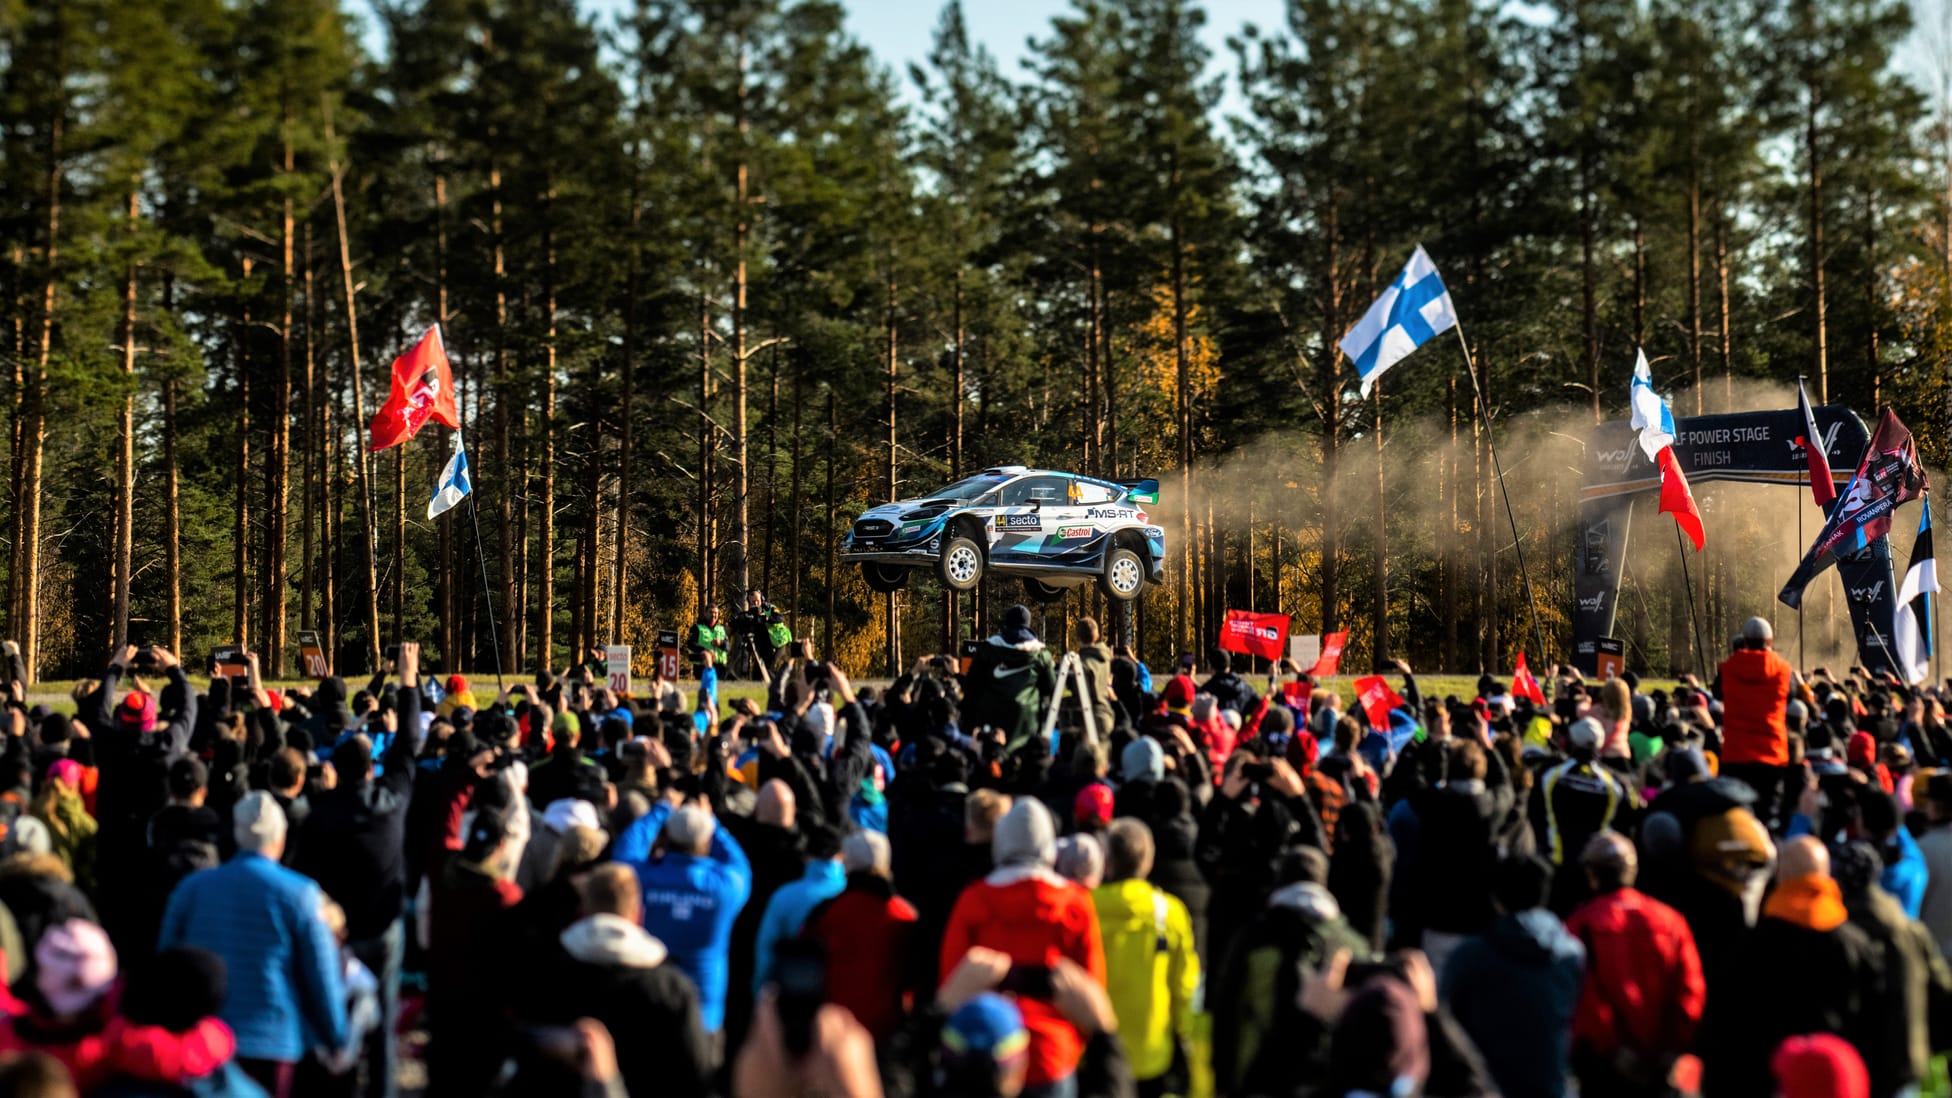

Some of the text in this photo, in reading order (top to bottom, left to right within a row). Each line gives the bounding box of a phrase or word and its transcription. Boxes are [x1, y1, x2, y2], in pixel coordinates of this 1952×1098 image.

[1689, 428, 1731, 446] POWER
[1733, 426, 1770, 442] STAGE
[1693, 450, 1732, 467] FINISH
[1010, 516, 1037, 526] secto
[1066, 527, 1091, 537] Castrol
[306, 655, 324, 676] 20
[661, 655, 676, 677] 15
[1605, 662, 1615, 681] 5
[610, 672, 628, 692] 20
